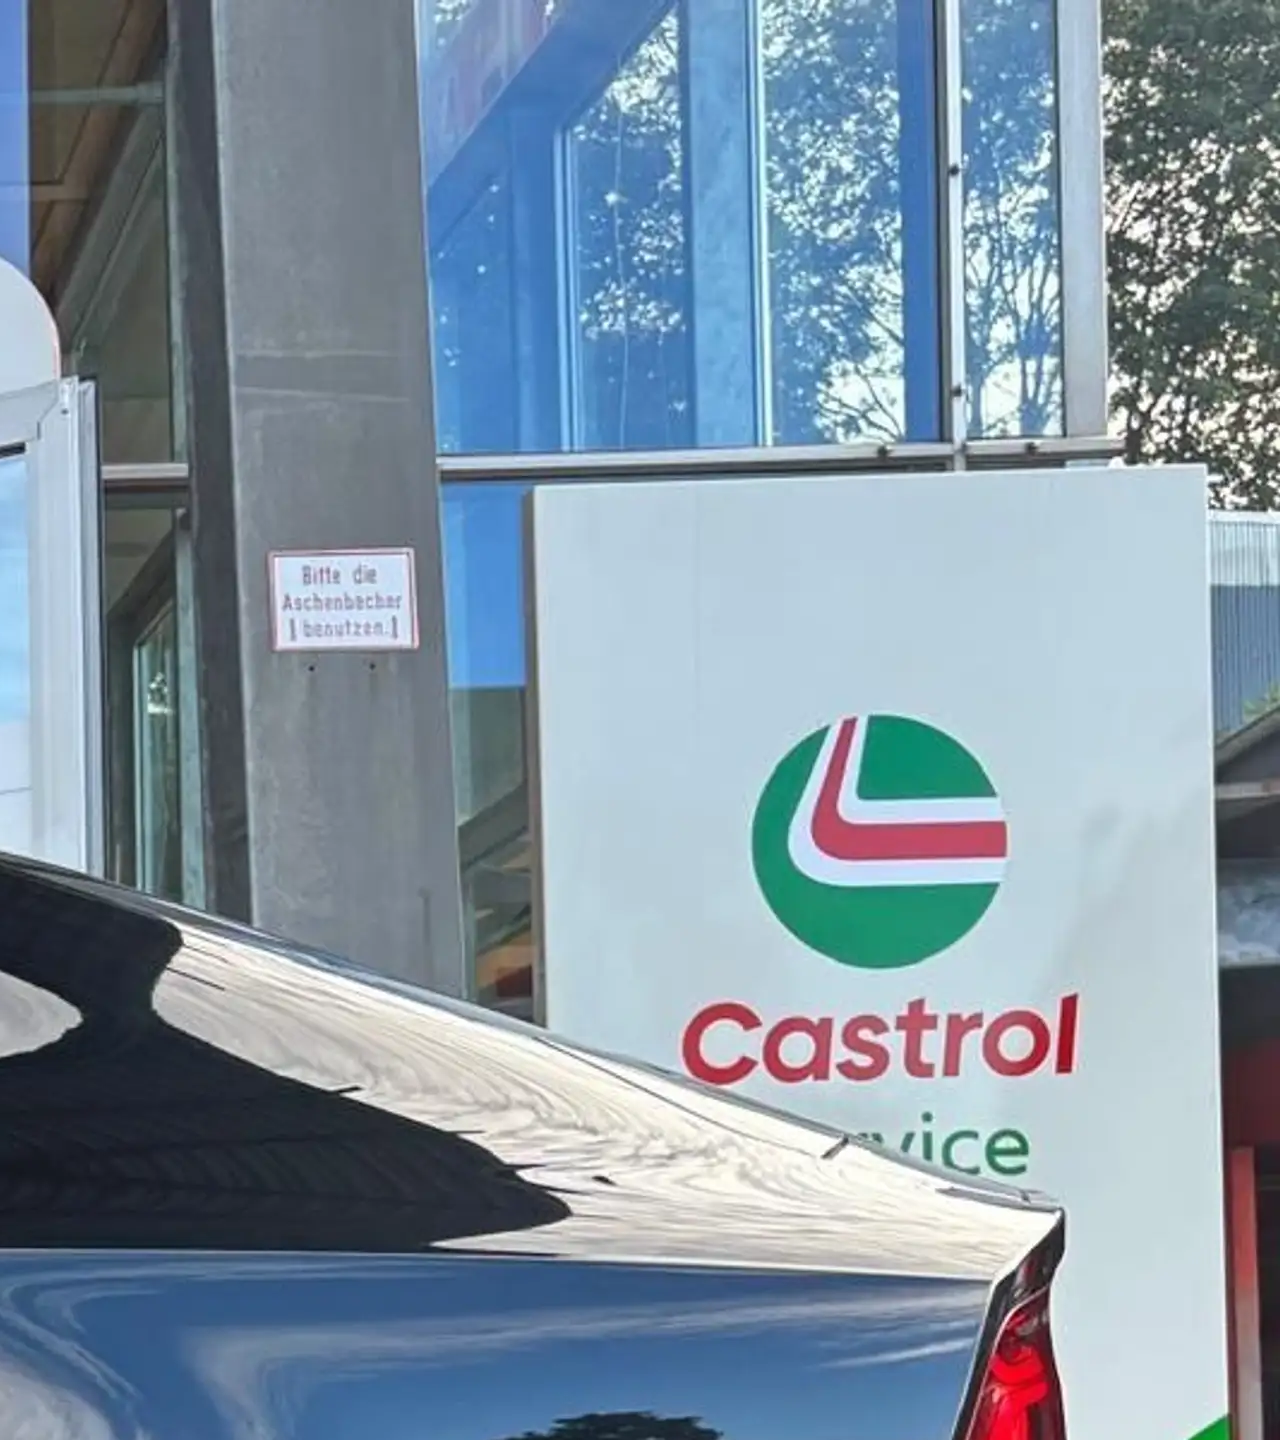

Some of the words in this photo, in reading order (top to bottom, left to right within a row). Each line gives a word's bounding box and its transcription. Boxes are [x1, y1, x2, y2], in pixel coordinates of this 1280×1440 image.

[301, 565, 341, 585] Bitte
[352, 564, 377, 585] die
[681, 993, 1080, 1086] Castrol
